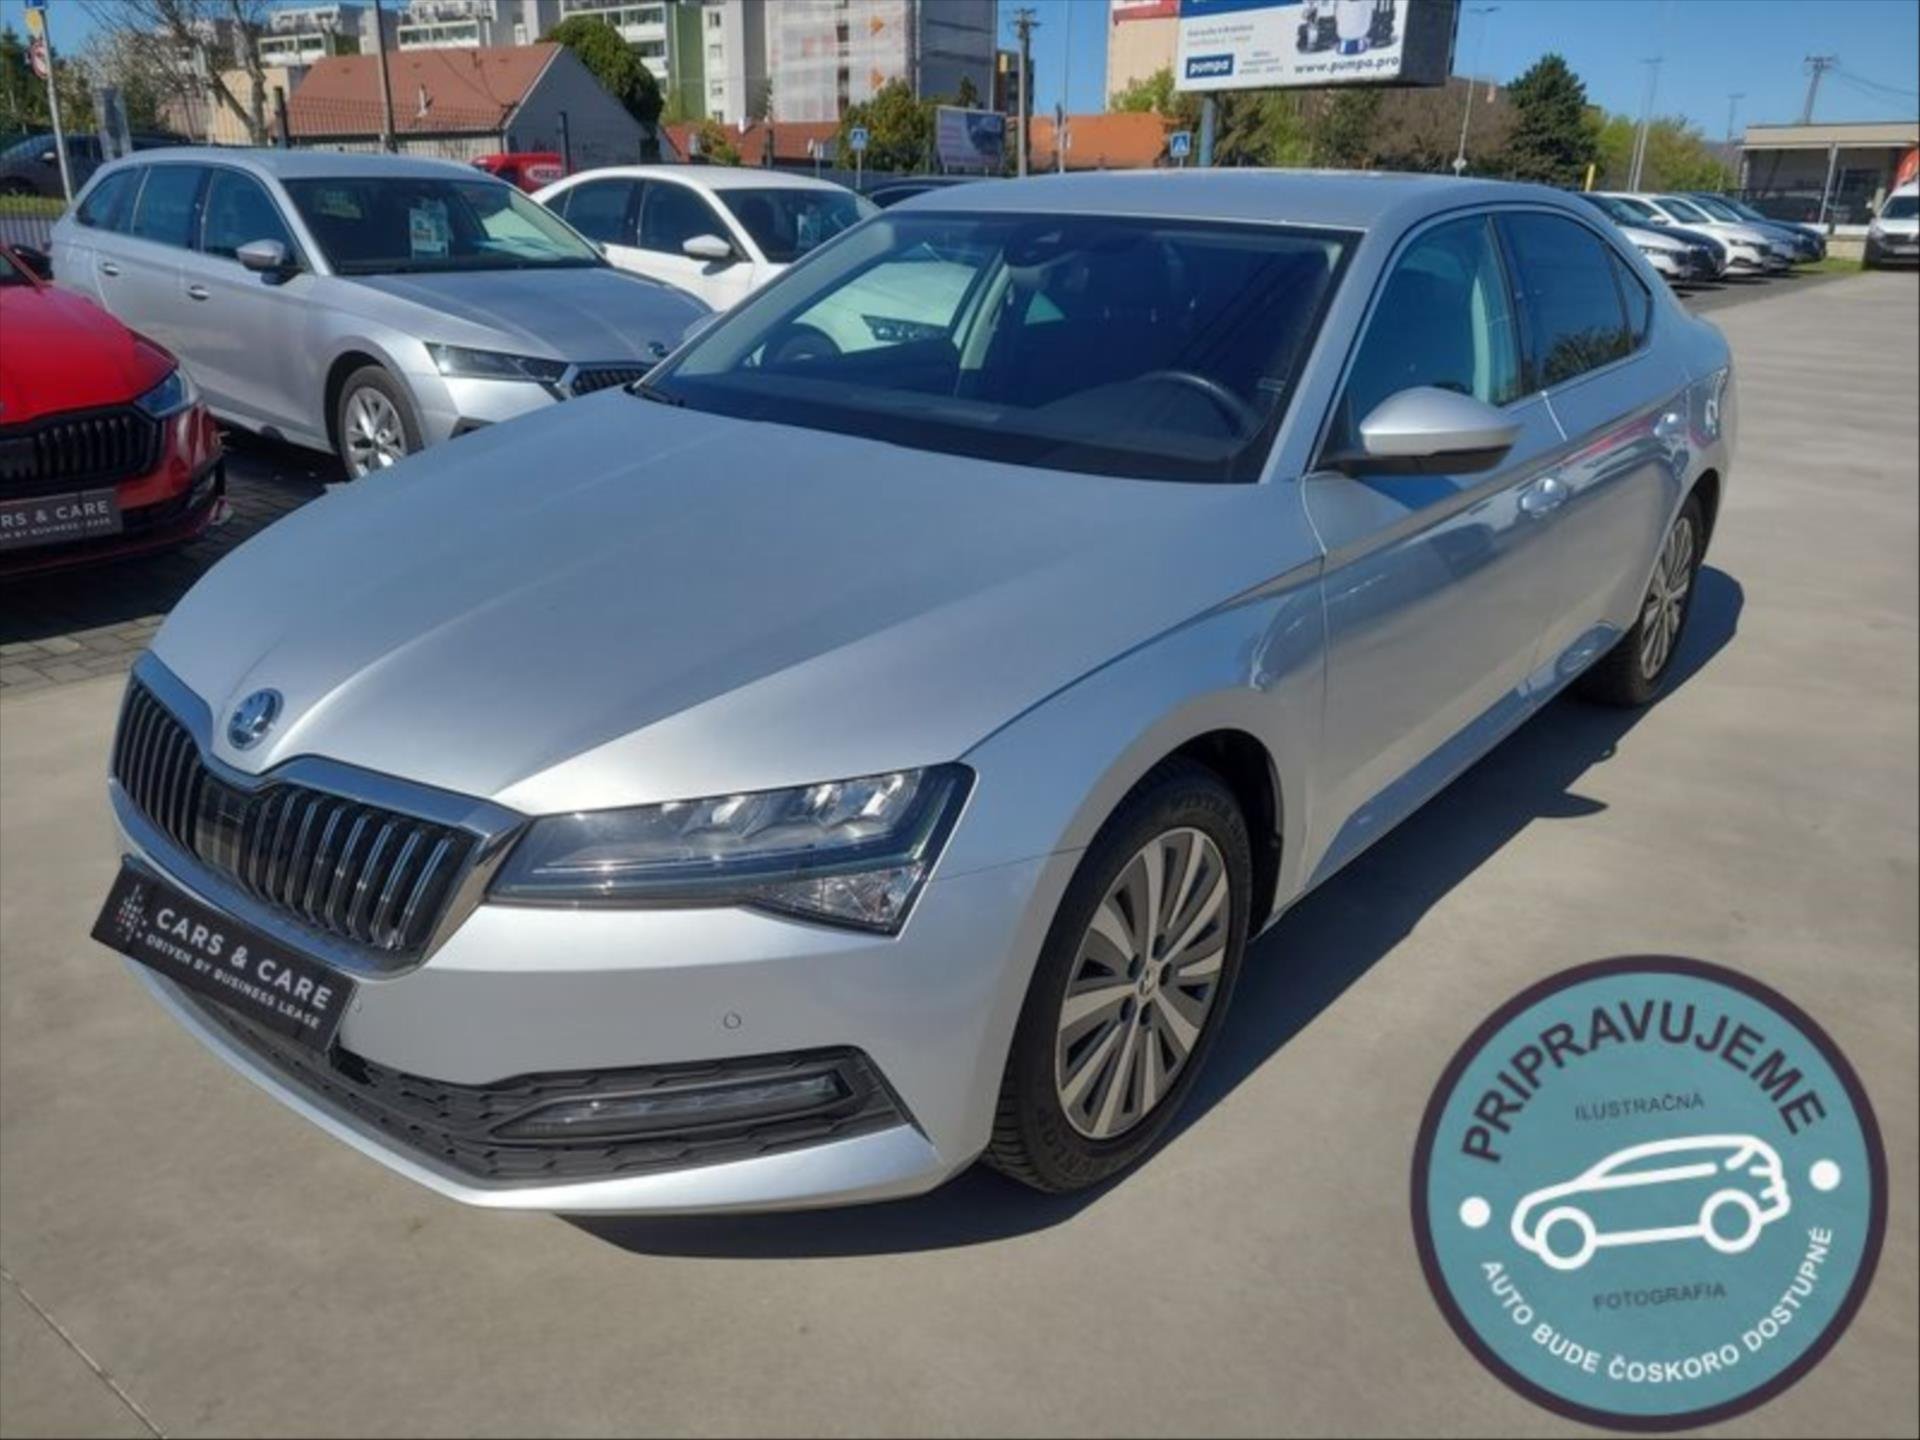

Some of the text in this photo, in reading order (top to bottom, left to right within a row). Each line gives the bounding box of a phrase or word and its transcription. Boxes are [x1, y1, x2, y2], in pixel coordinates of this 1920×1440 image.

[1295, 56, 1399, 74] www.pumpa.pro
[56, 500, 108, 519] CARE
[146, 934, 321, 1030] DRIVEN BY BUSINESS LEASE
[156, 908, 333, 1010] CARS & CARE
